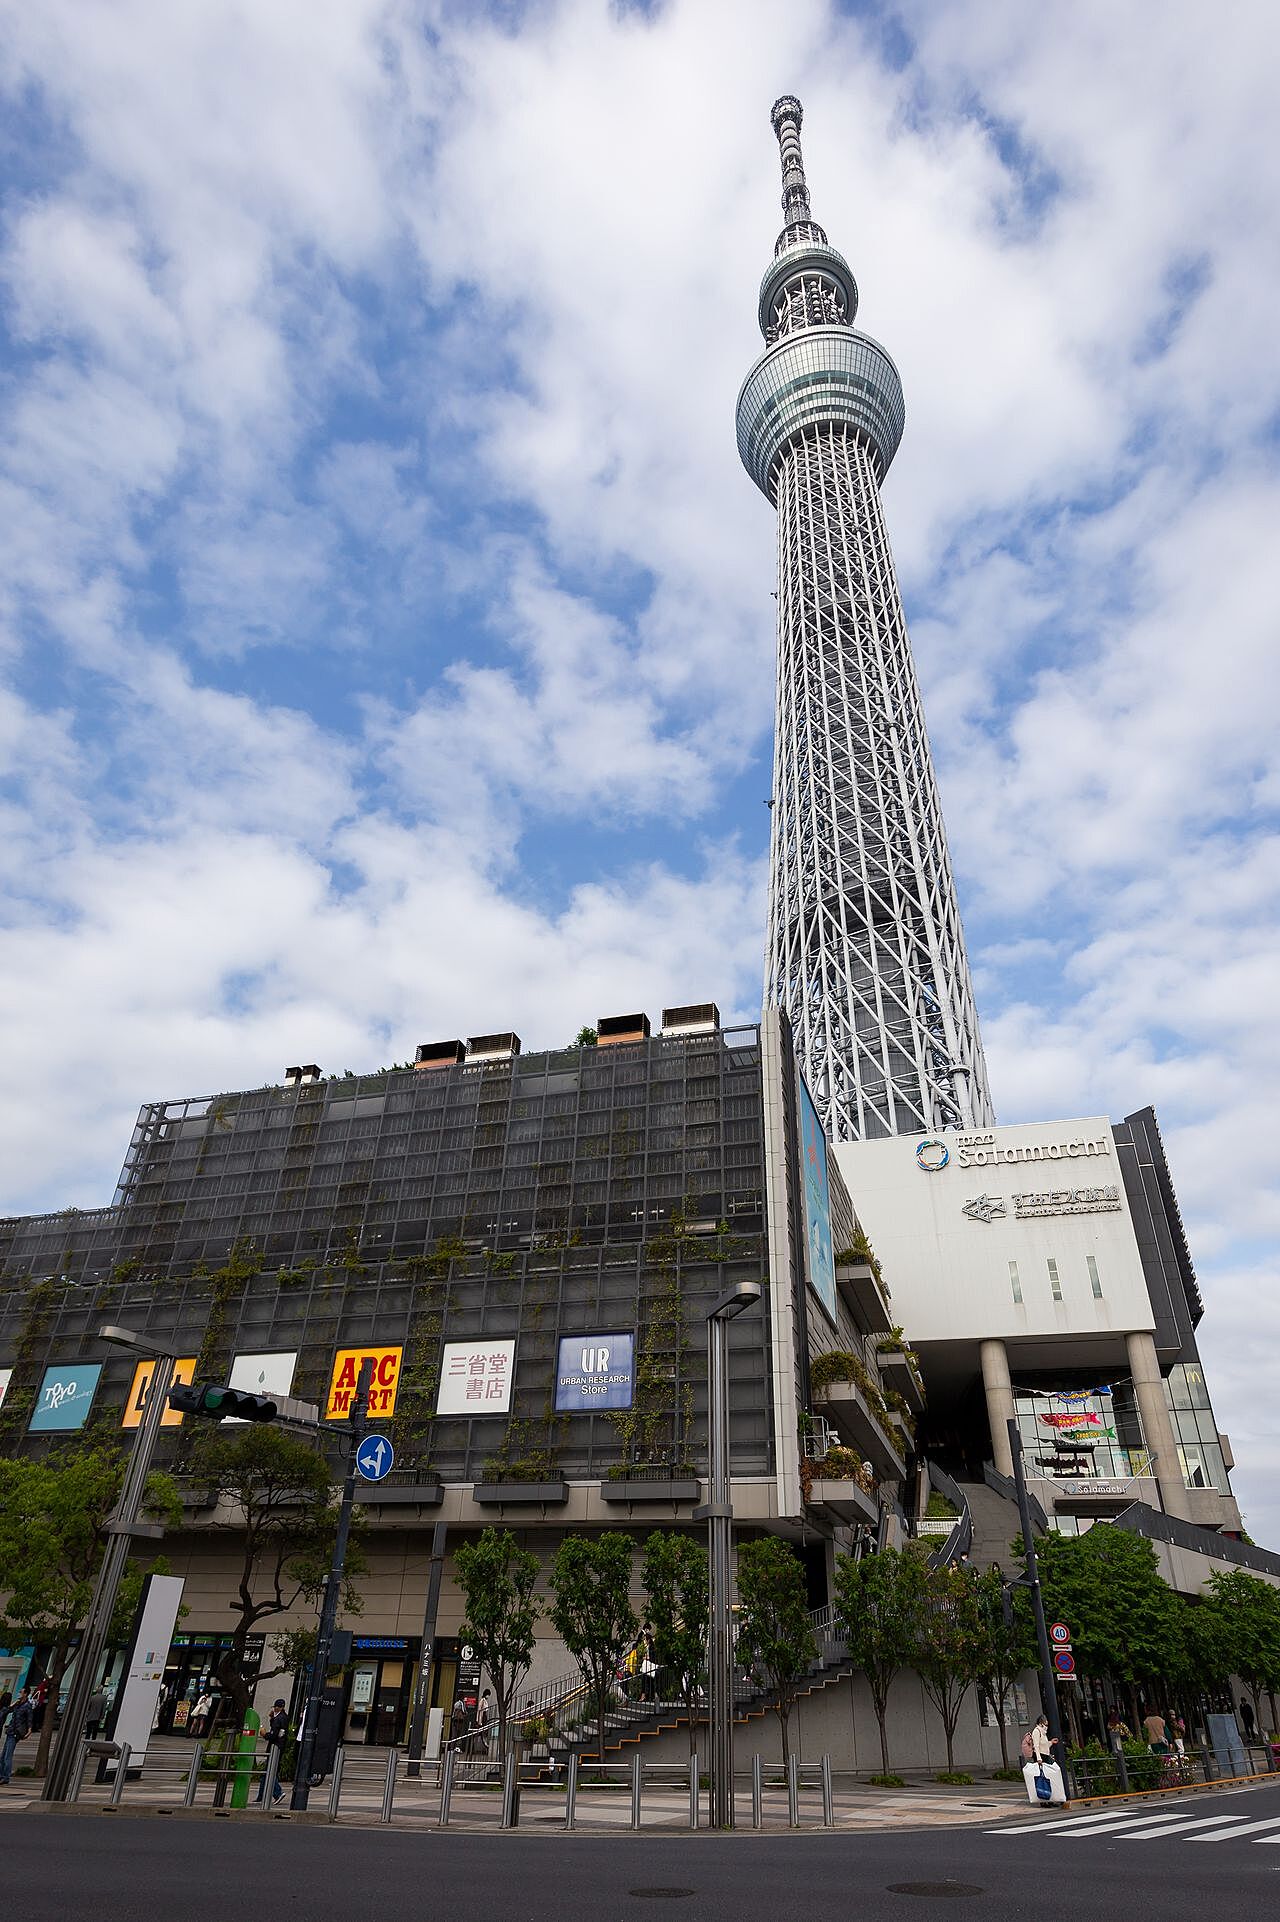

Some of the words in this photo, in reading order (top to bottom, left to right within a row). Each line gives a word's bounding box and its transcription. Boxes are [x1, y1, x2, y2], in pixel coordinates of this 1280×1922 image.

[958, 1137, 1110, 1168] Solamachi
[448, 1353, 508, 1375] 三省堂
[581, 1347, 609, 1373] UR
[465, 1377, 505, 1400] 書店
[560, 1377, 587, 1385] URBAN
[588, 1375, 630, 1384] RESEARCH
[581, 1384, 608, 1395] Store
[331, 1388, 393, 1412] MRT
[1055, 1628, 1066, 1639] 40
